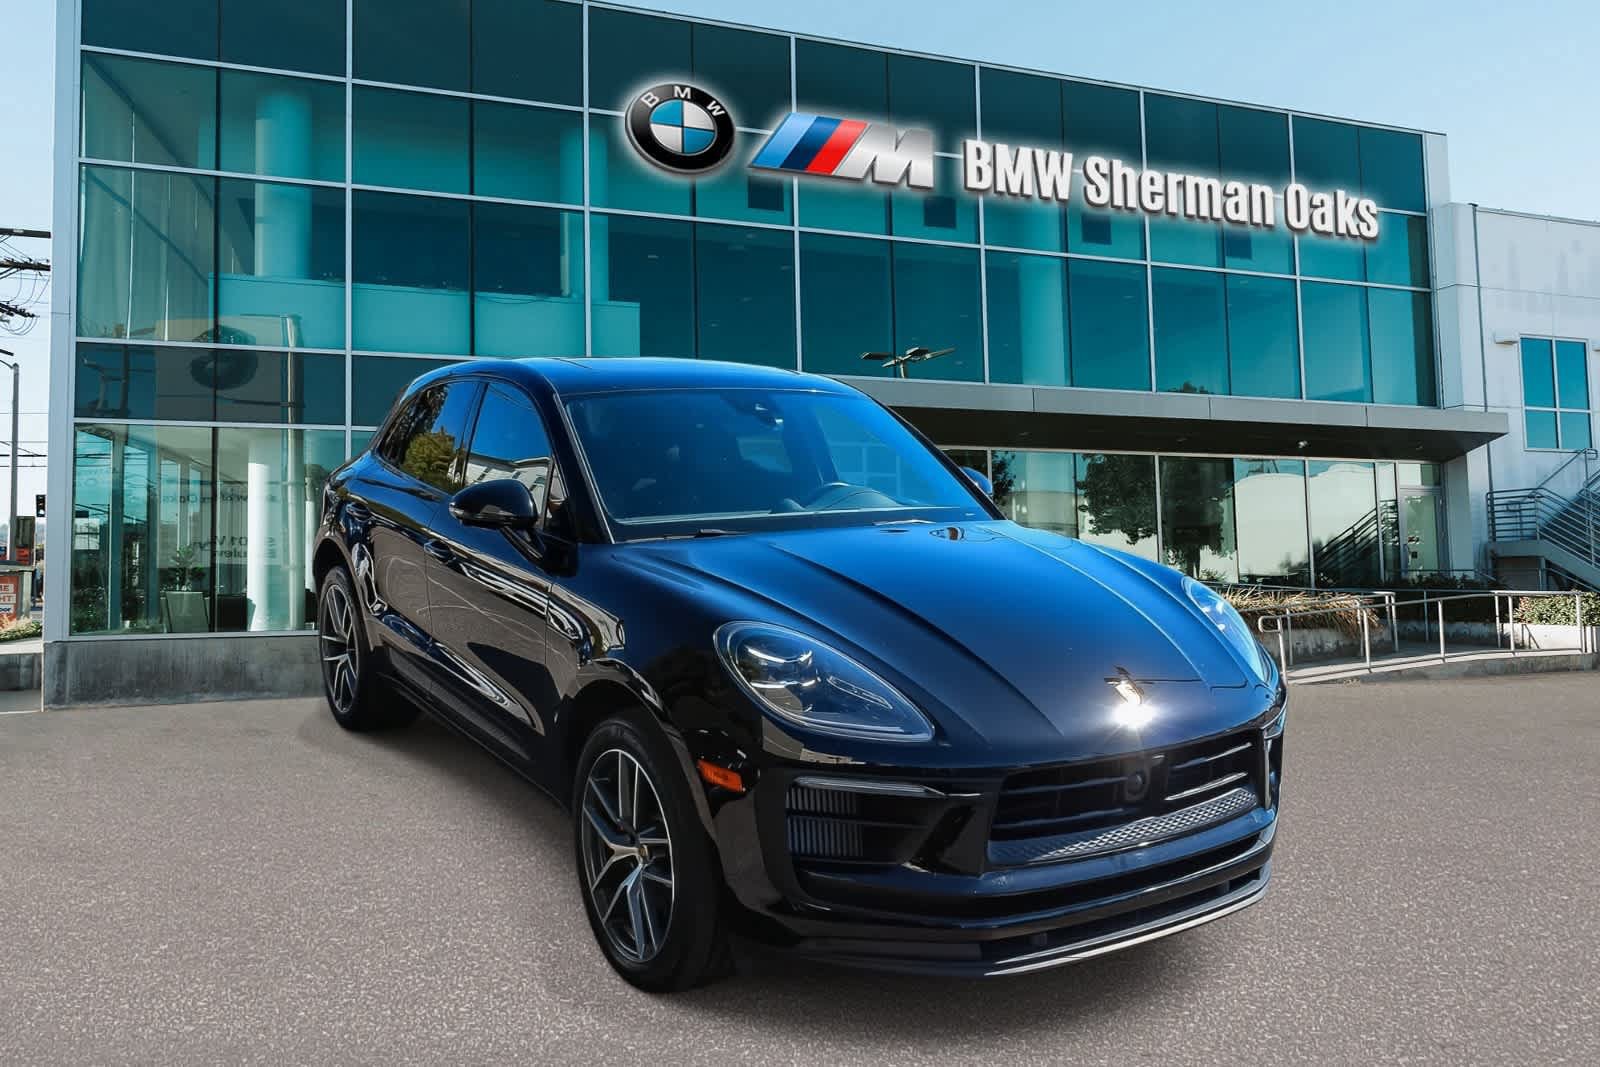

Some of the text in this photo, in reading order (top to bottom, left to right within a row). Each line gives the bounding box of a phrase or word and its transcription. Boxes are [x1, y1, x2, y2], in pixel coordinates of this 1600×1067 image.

[640, 85, 725, 117] BMW
[963, 138, 1380, 240] BMW Sherman Oaks
